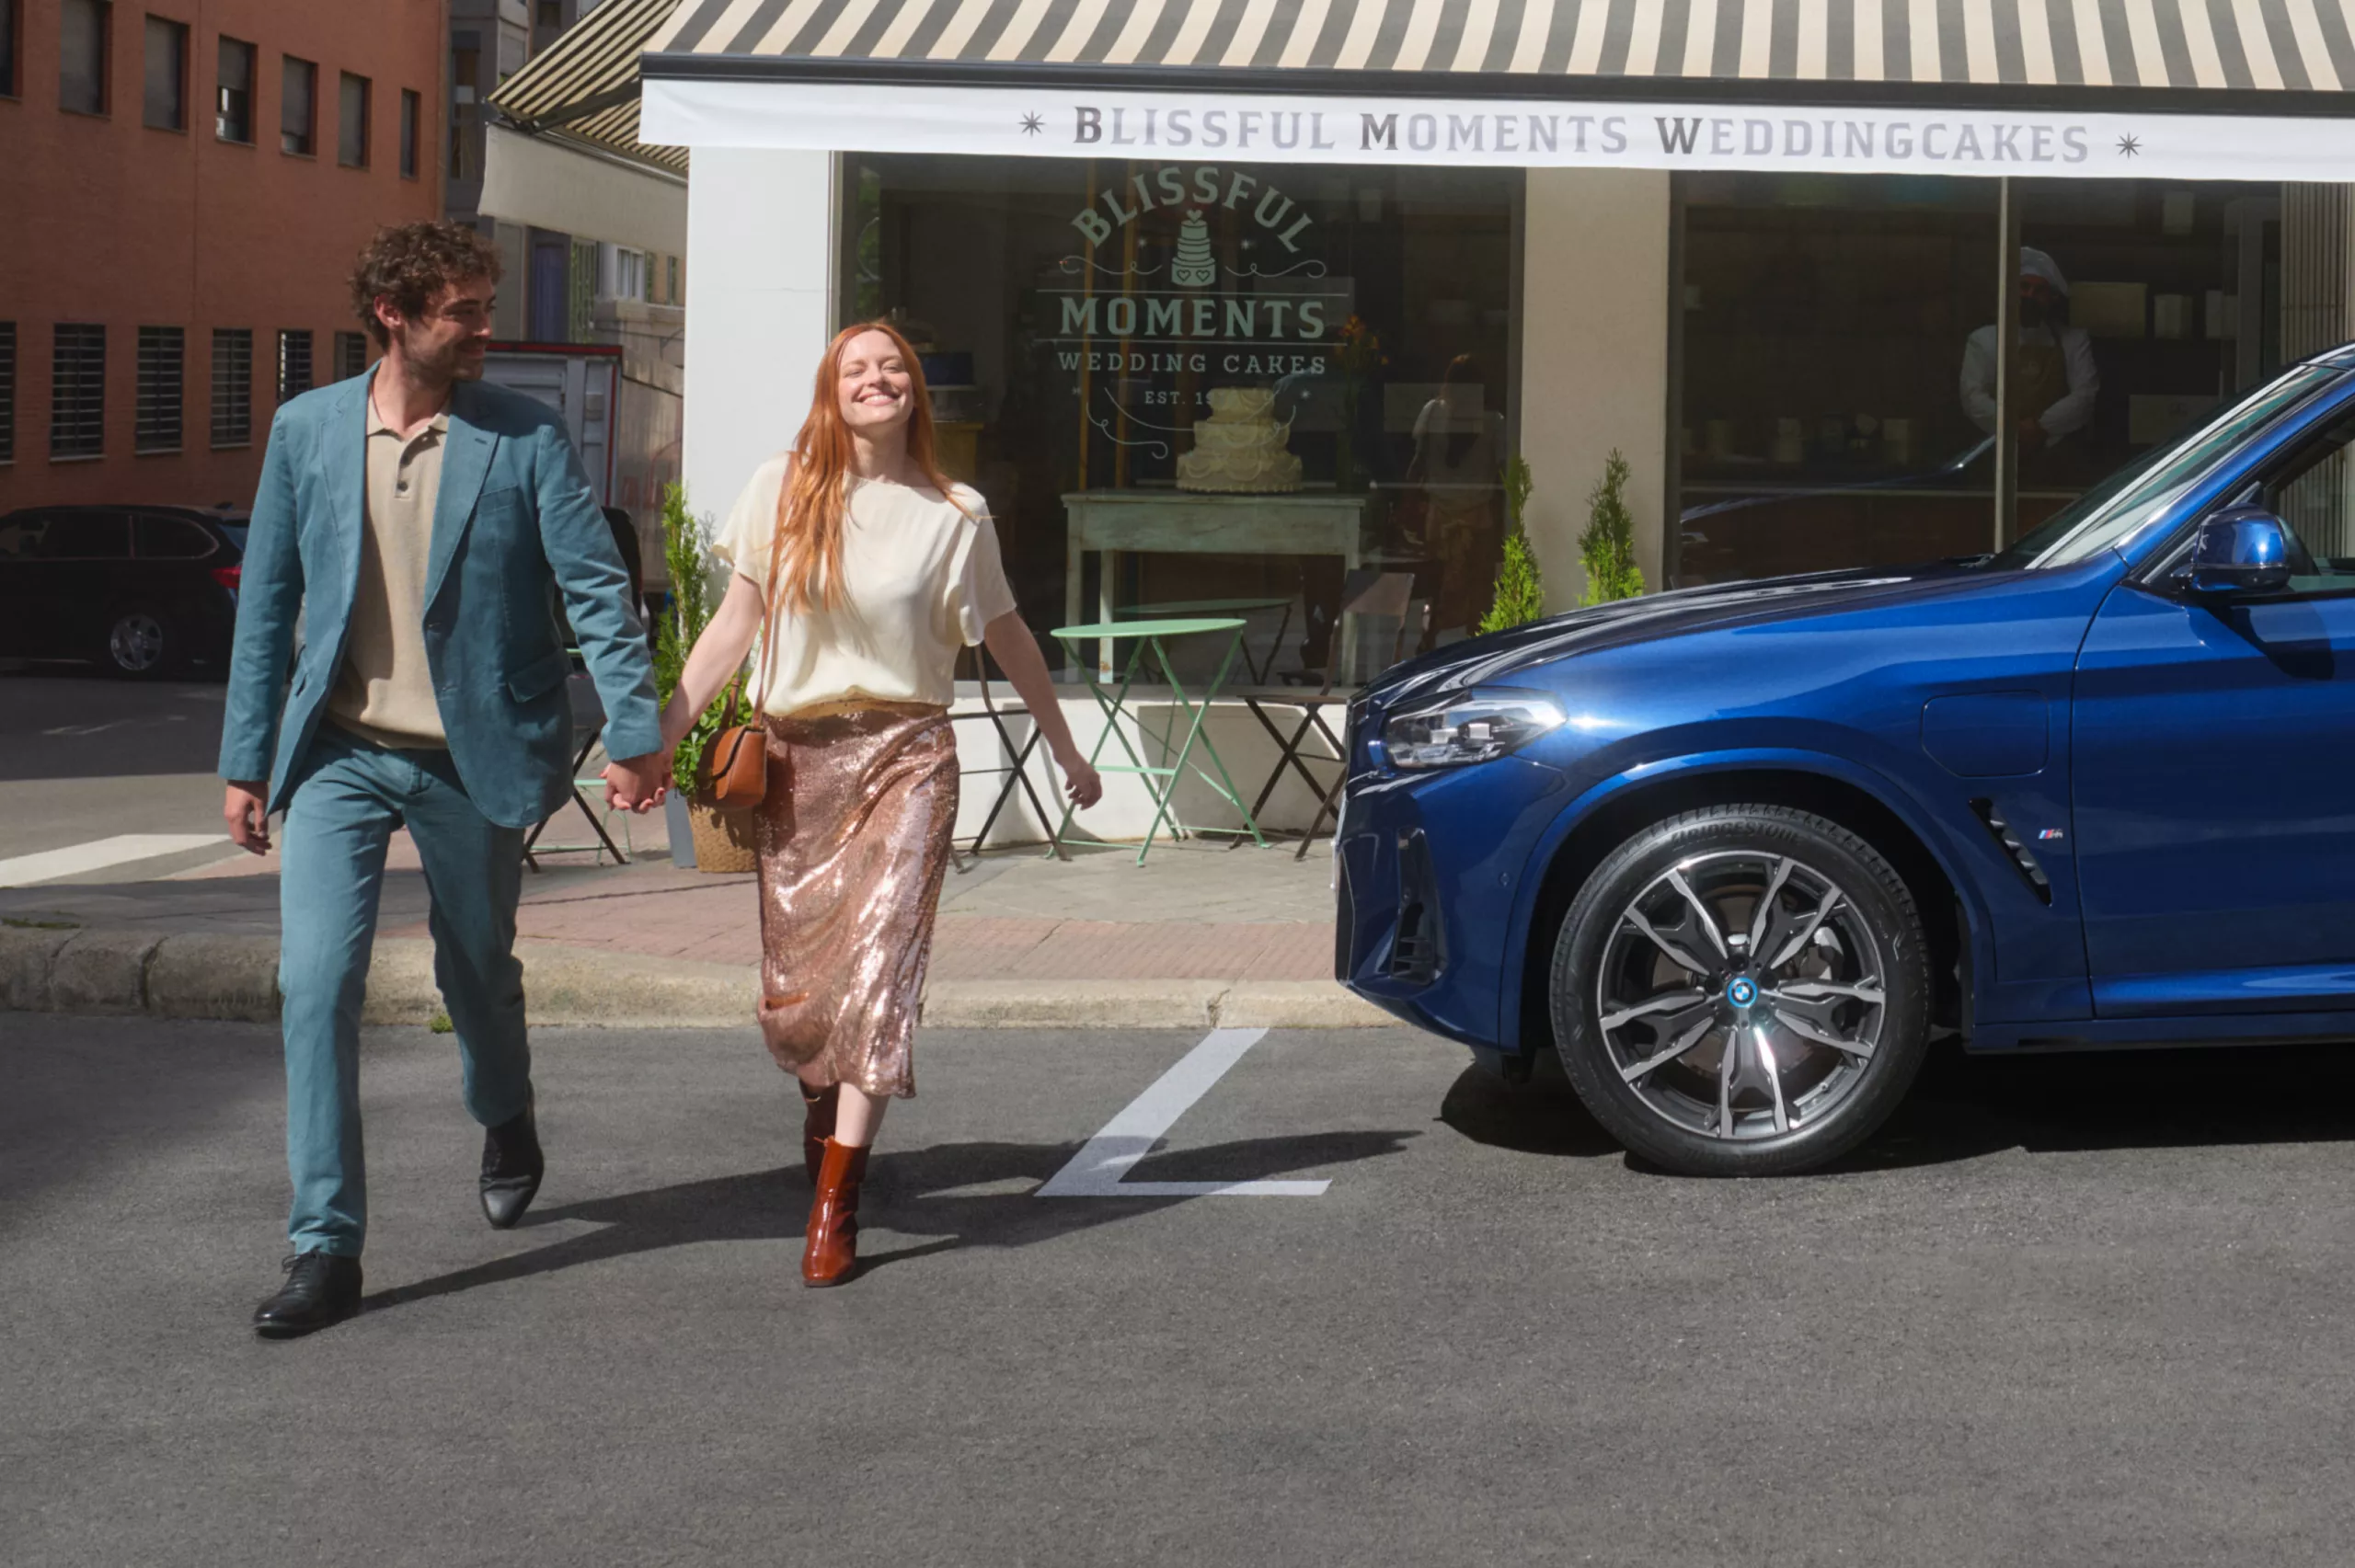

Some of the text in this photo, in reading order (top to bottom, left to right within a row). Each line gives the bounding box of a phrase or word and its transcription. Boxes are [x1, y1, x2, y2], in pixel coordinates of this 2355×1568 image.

[1073, 106, 2089, 163] BLISSFUL MOMENTS WEDDINGCAKES
[1070, 166, 1314, 254] BLISSFUL
[1059, 296, 1325, 339] MOMENTS
[1058, 352, 1326, 375] WEDDING CAKES
[1144, 391, 1187, 405] EST.
